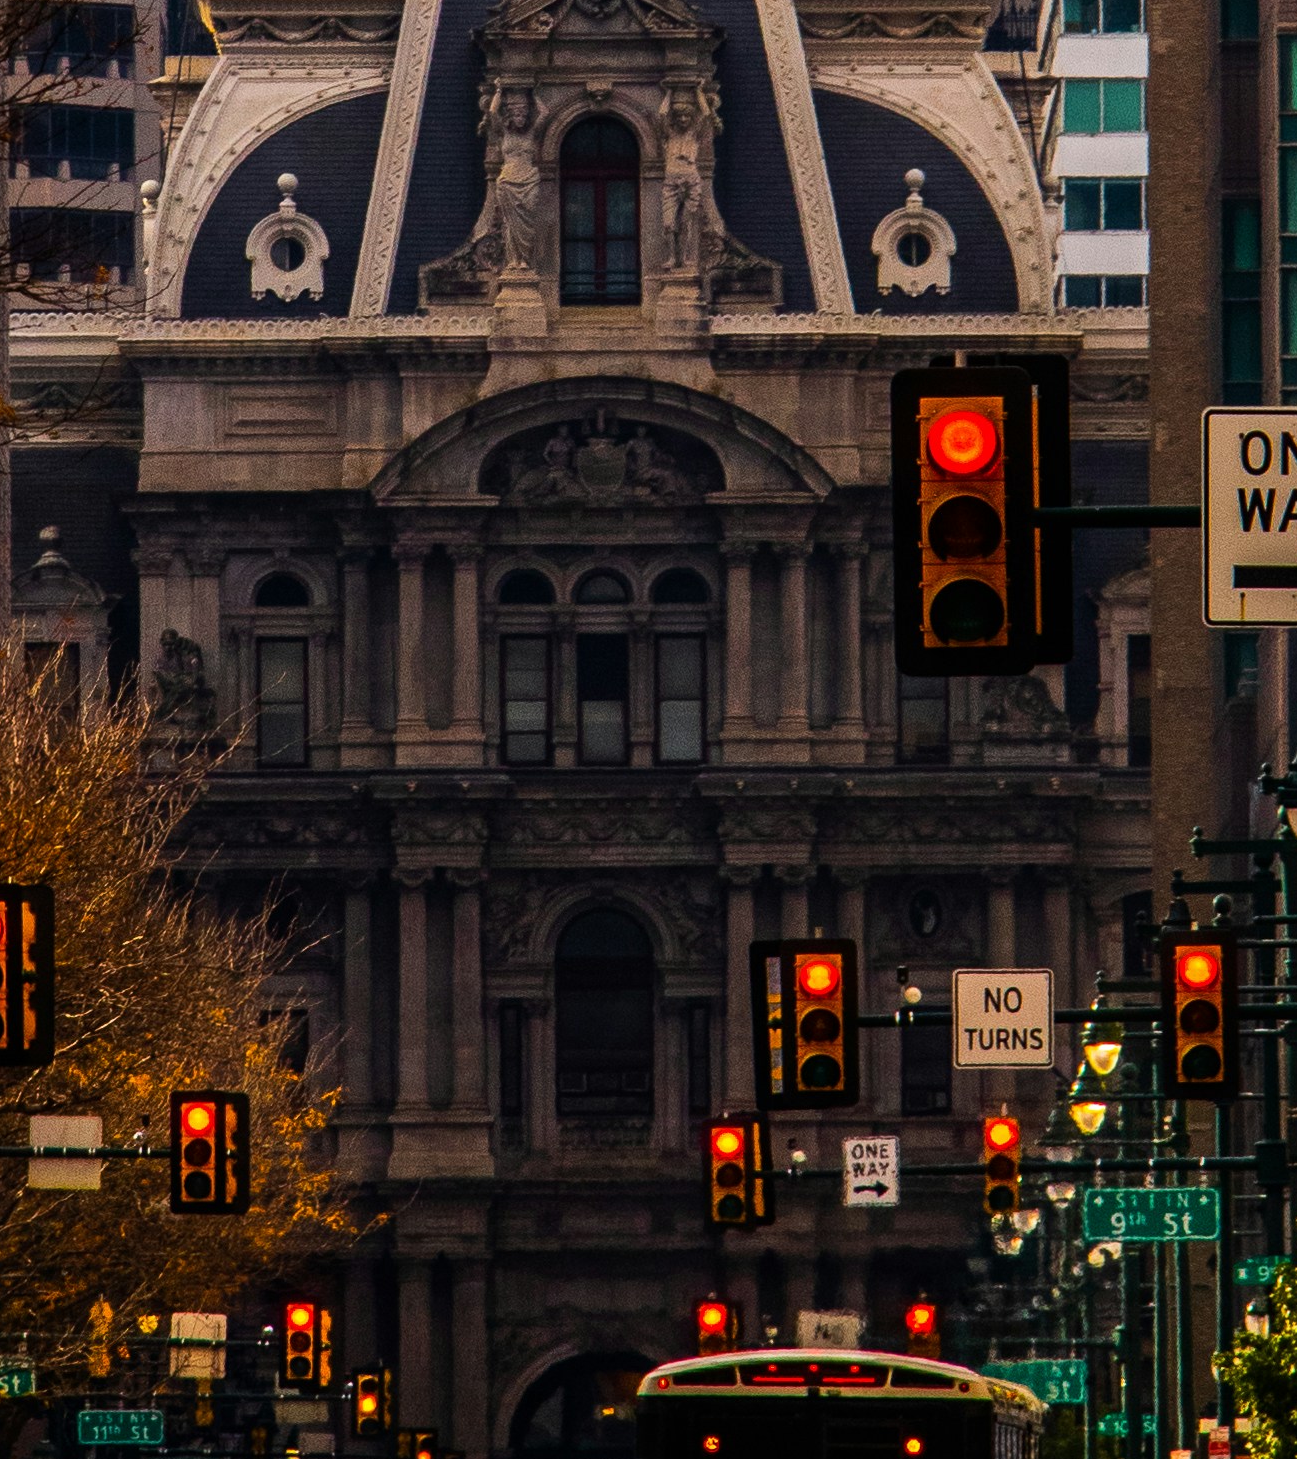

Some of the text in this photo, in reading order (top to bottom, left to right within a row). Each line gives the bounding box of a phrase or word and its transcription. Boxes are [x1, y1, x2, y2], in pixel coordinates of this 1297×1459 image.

[984, 987, 1023, 1013] NO
[964, 1028, 1043, 1050] TURNS
[851, 1143, 889, 1159] ONE
[852, 1162, 890, 1178] WAY
[1109, 1211, 1194, 1236] 9th St
[93, 1425, 150, 1440] 11th St
